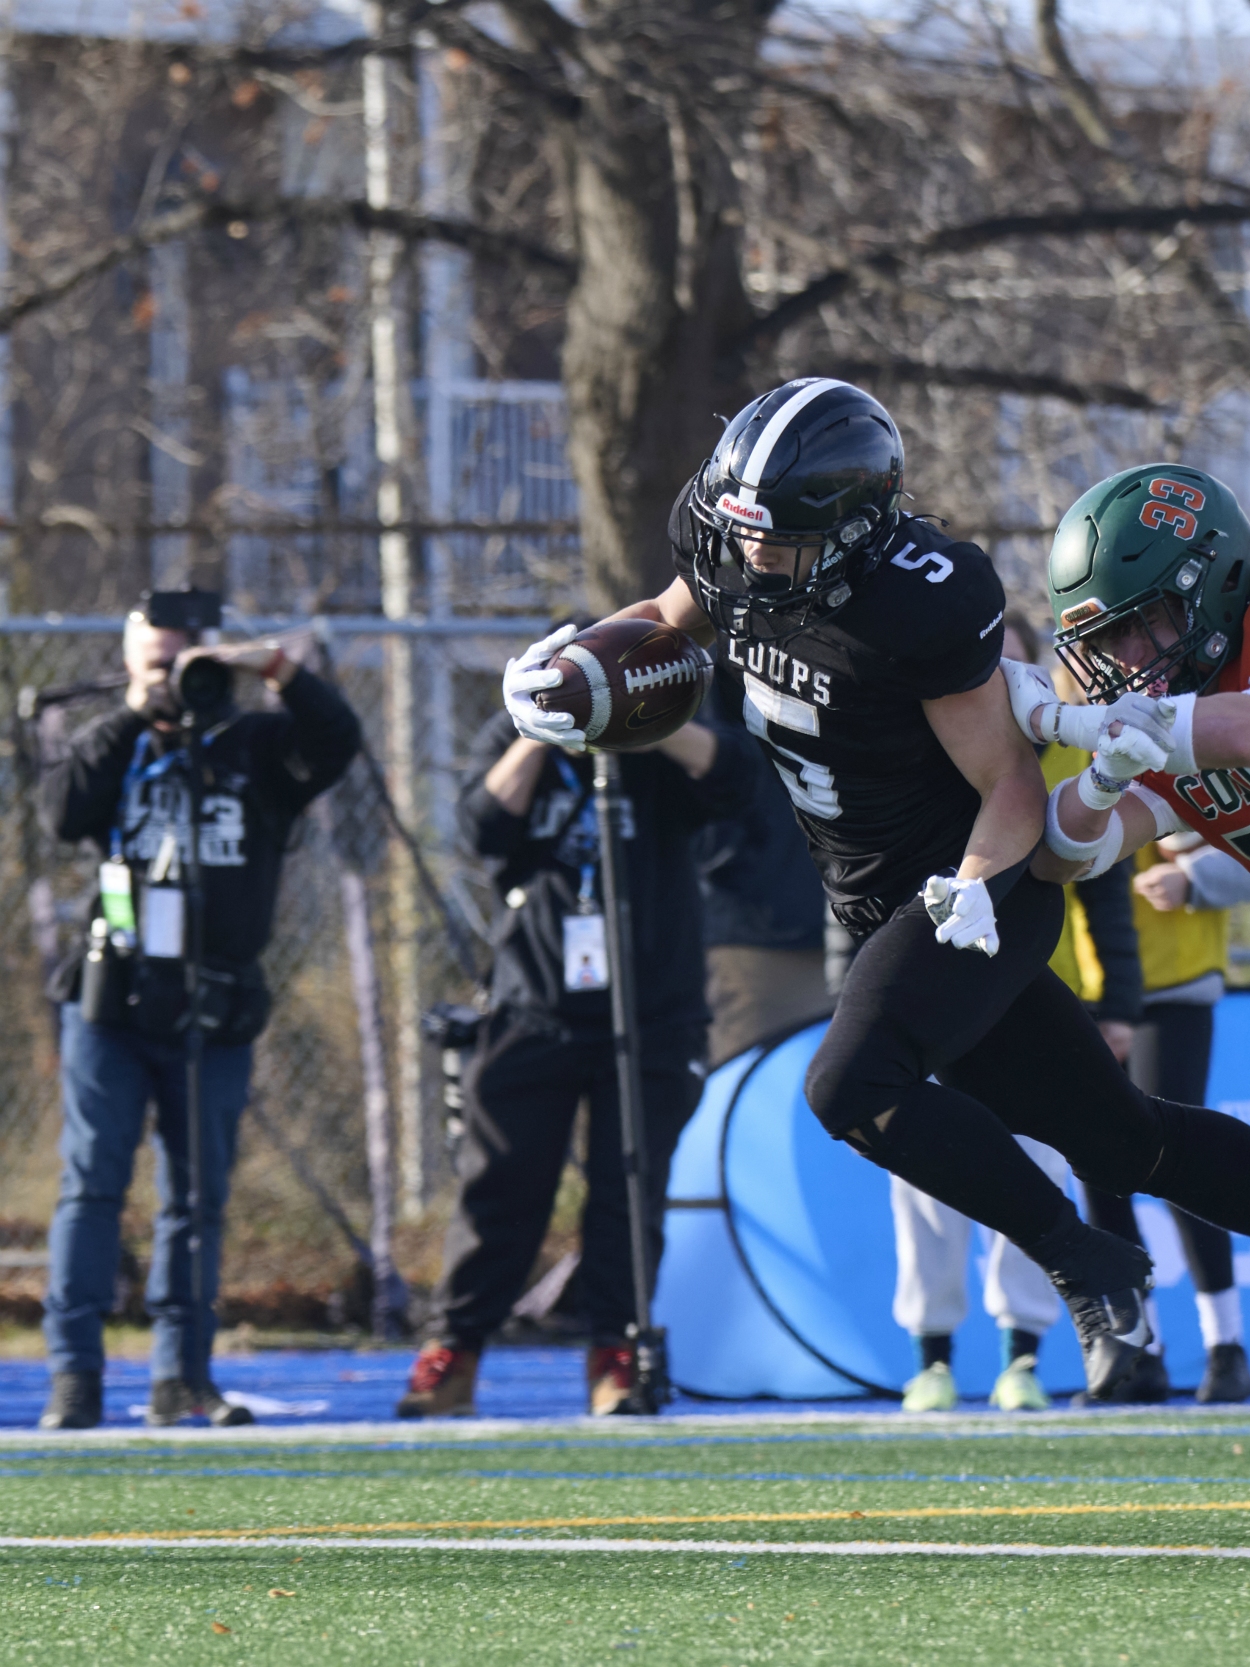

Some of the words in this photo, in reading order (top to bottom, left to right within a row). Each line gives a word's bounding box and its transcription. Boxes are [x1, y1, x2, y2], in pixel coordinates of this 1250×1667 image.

[722, 497, 764, 523] Riddell
[1138, 477, 1207, 542] 33
[889, 541, 955, 584] 5
[979, 610, 1004, 640] Riddell
[728, 637, 831, 707] LOUPS
[743, 670, 844, 822] 5
